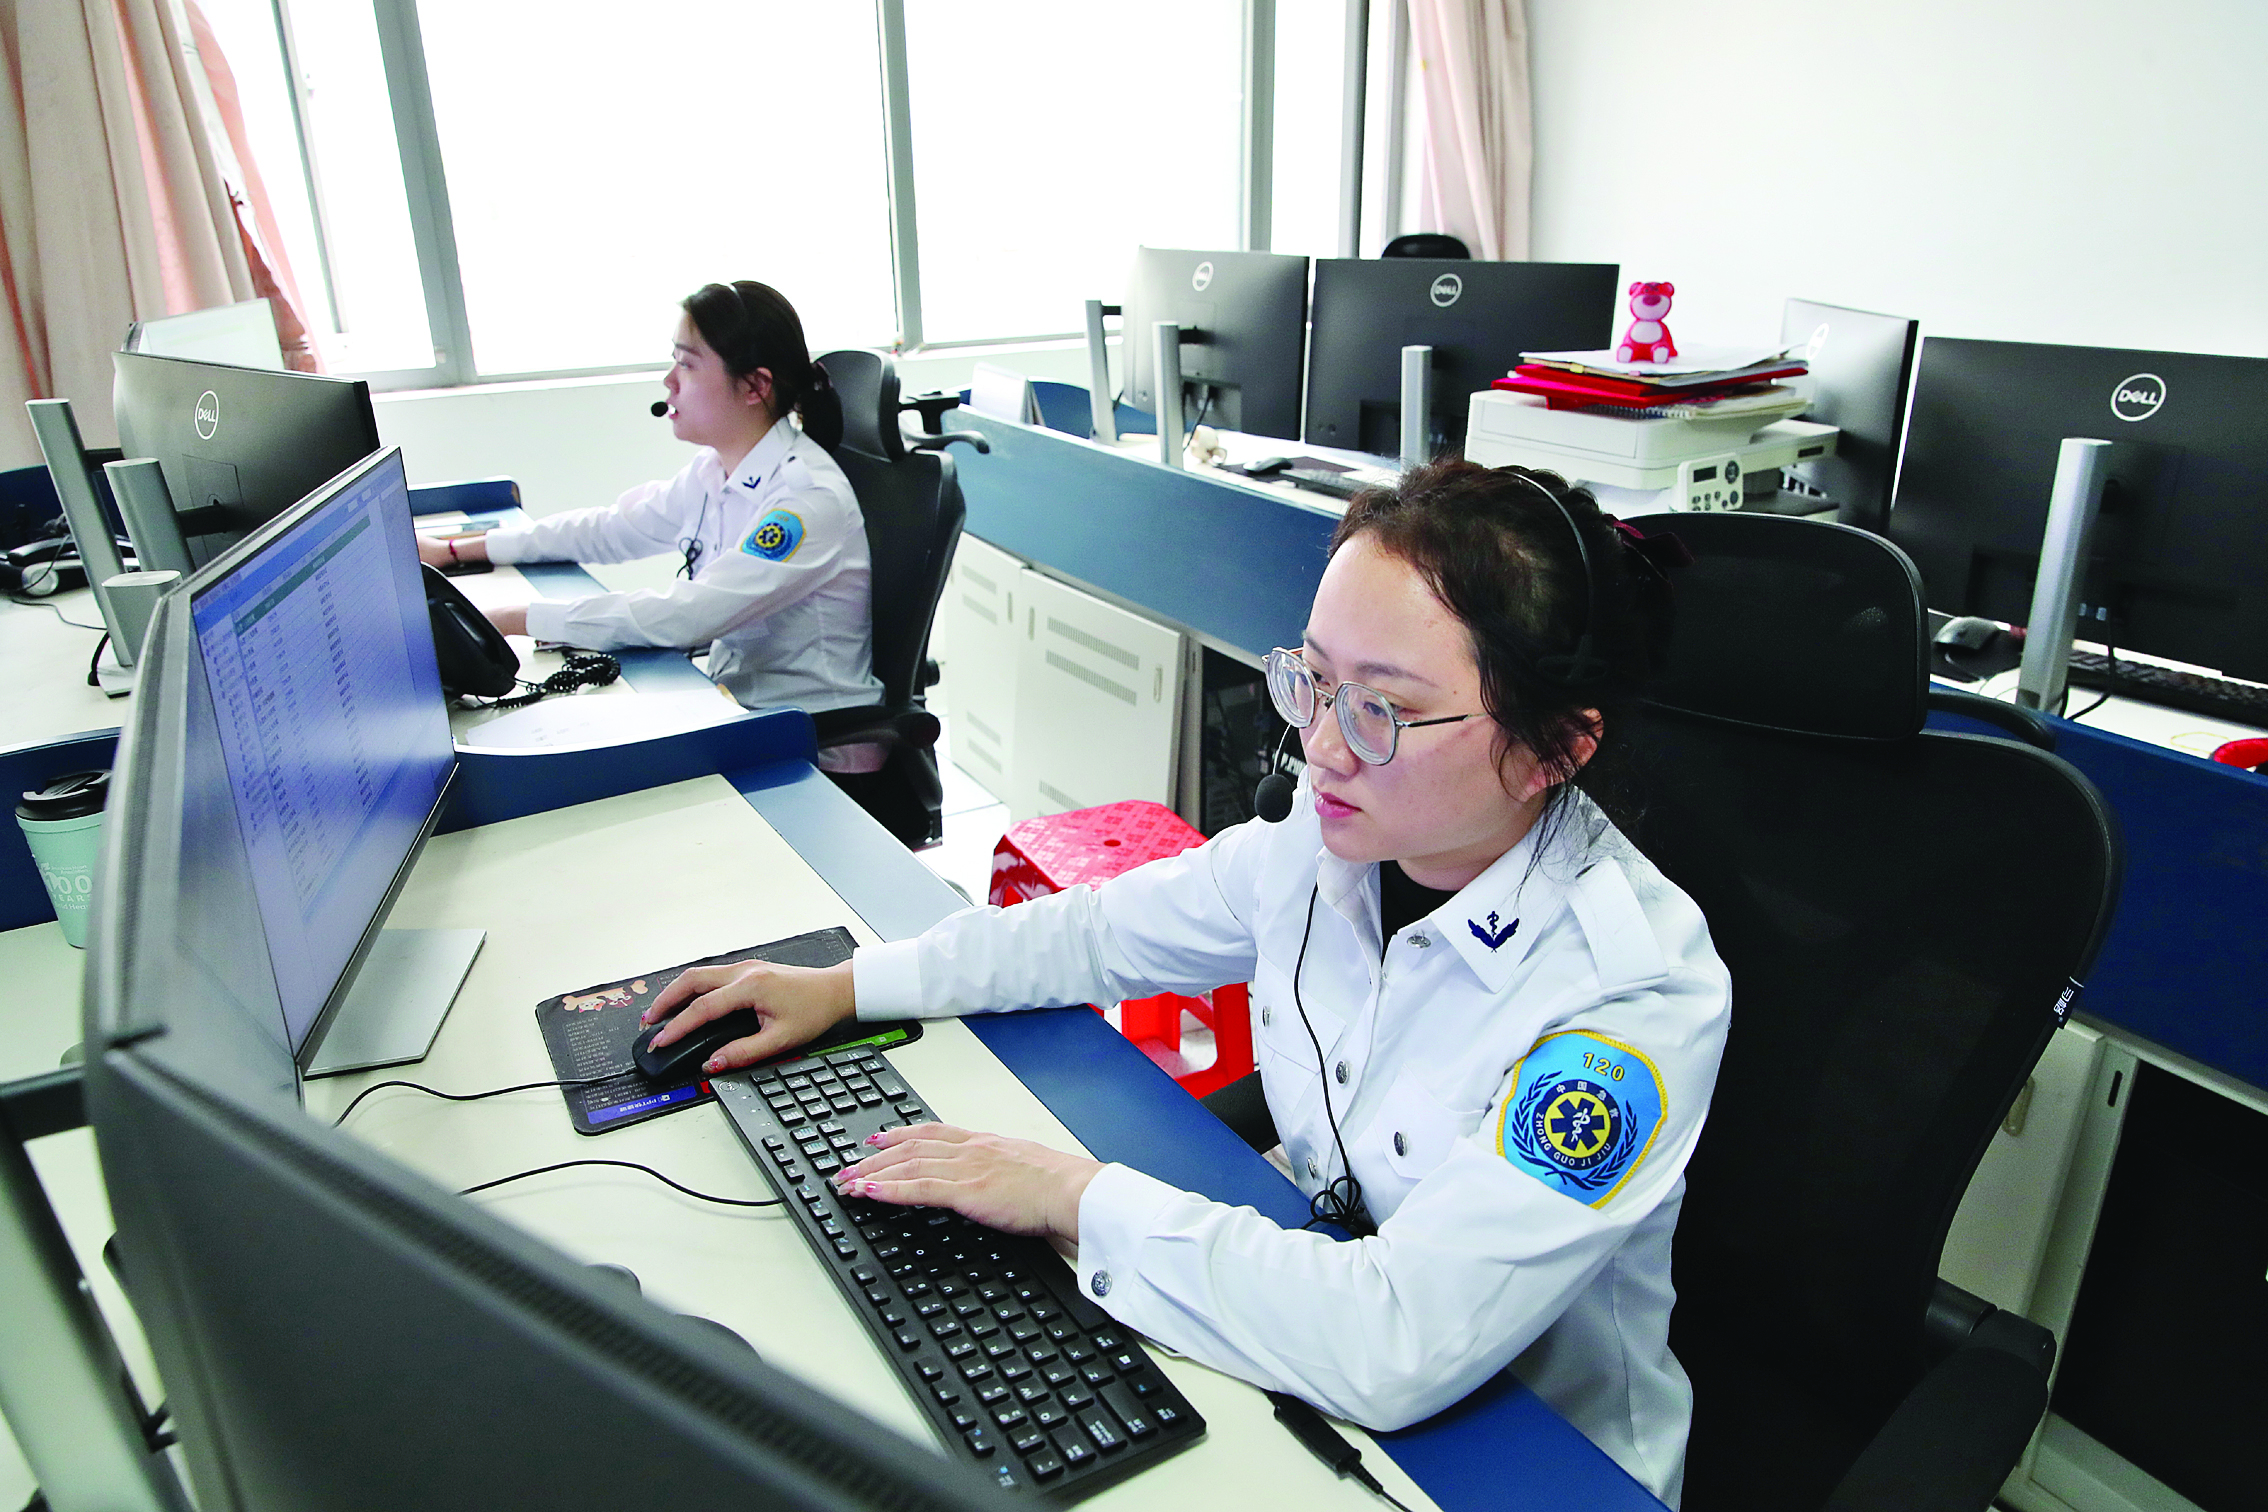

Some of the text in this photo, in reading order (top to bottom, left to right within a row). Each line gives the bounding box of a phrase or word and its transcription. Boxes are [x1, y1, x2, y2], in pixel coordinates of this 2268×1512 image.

[2118, 389, 2158, 405] DELL
[198, 408, 216, 422] DELL
[1583, 1052, 1625, 1081] 120
[1556, 1081, 1619, 1118] 中国急救
[1536, 1112, 1611, 1167] ZHONG GUO JI JIU
